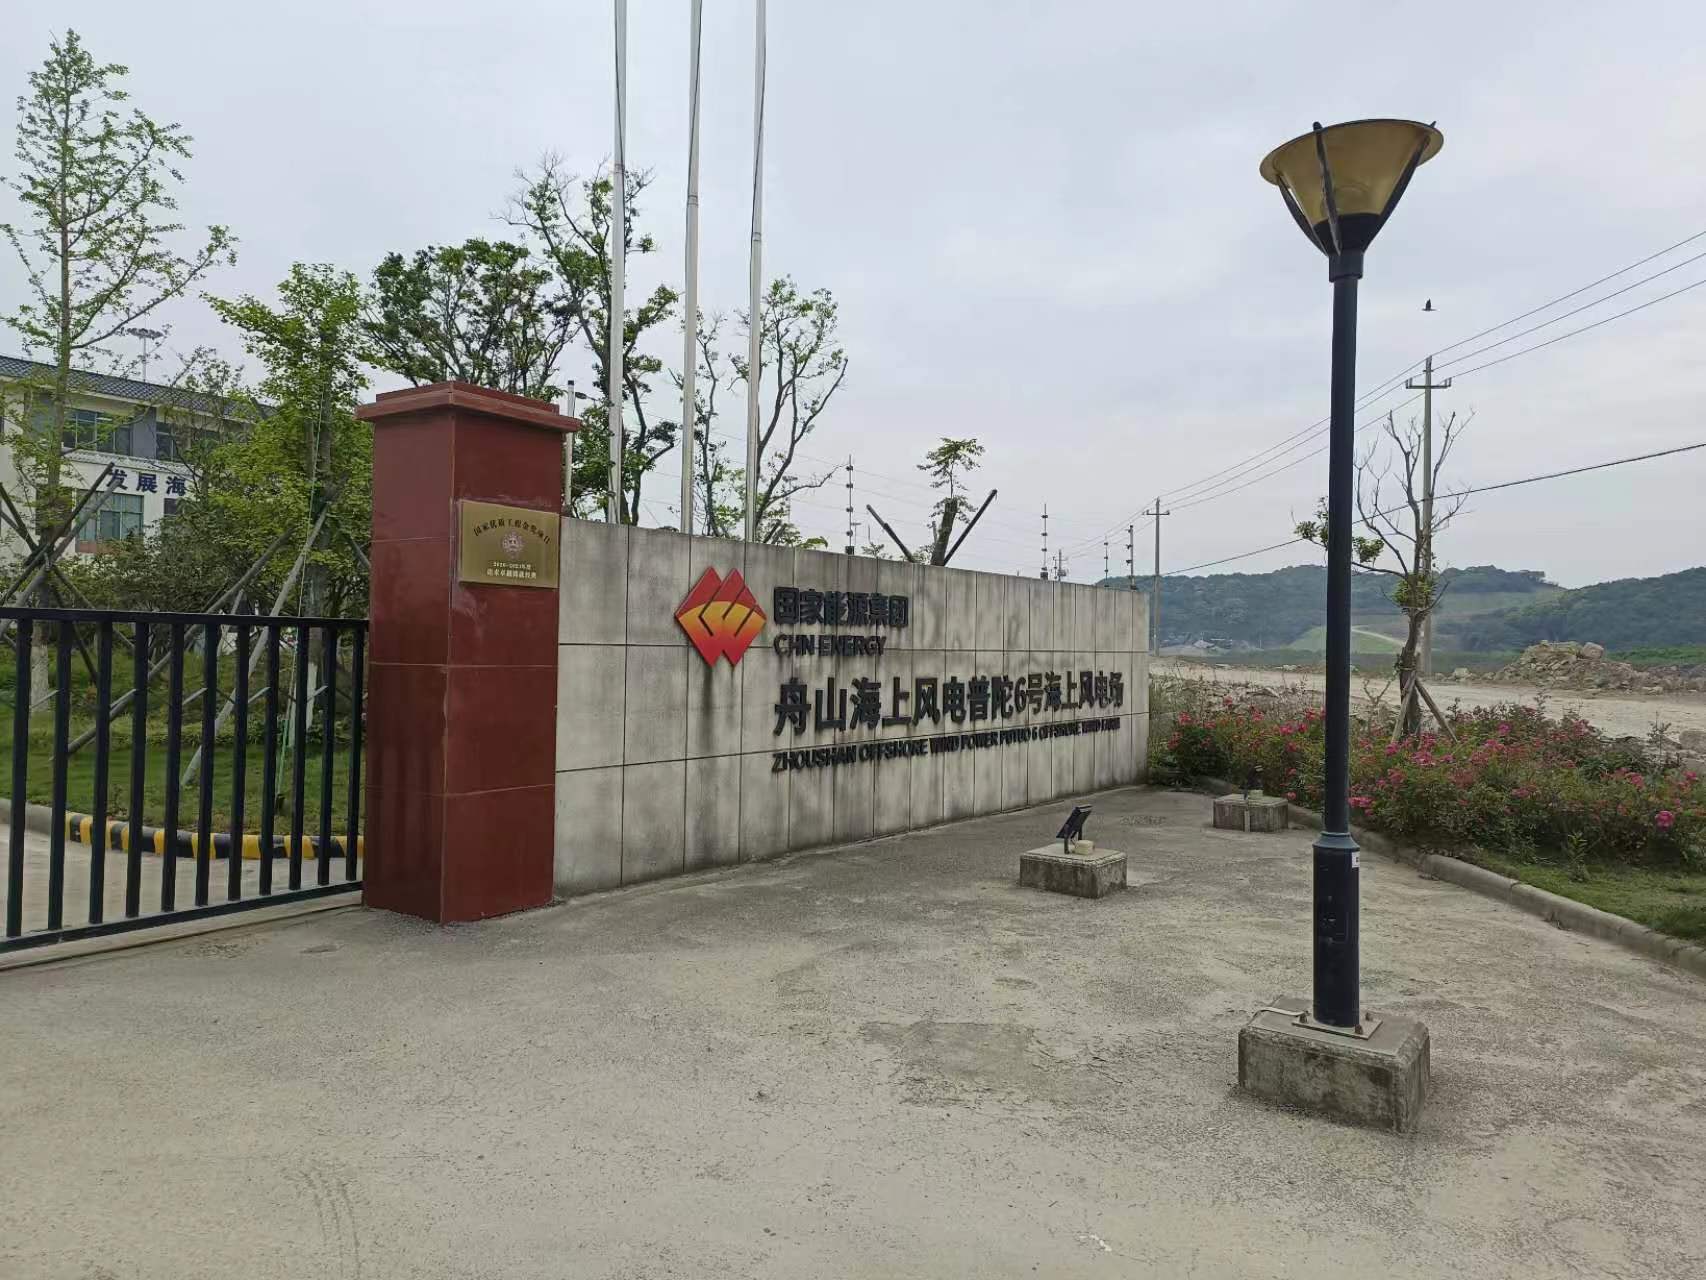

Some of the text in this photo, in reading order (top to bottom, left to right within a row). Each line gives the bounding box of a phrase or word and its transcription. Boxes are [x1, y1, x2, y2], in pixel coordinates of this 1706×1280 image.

[774, 587, 909, 627] 国家能源集团
[773, 634, 887, 657] CHN ENERGY
[773, 673, 1124, 736] 舟山海上风电普陀6号海上风电场
[772, 745, 857, 772] ZHOUSHAN
[858, 738, 928, 762] OFFSHORE
[929, 735, 959, 754] WIND
[961, 732, 999, 750] POWER
[1000, 728, 1030, 745] PUTUO
[1031, 726, 1038, 741] 6
[1039, 721, 1081, 741] OFFSHORE
[1082, 719, 1100, 735] WIND
